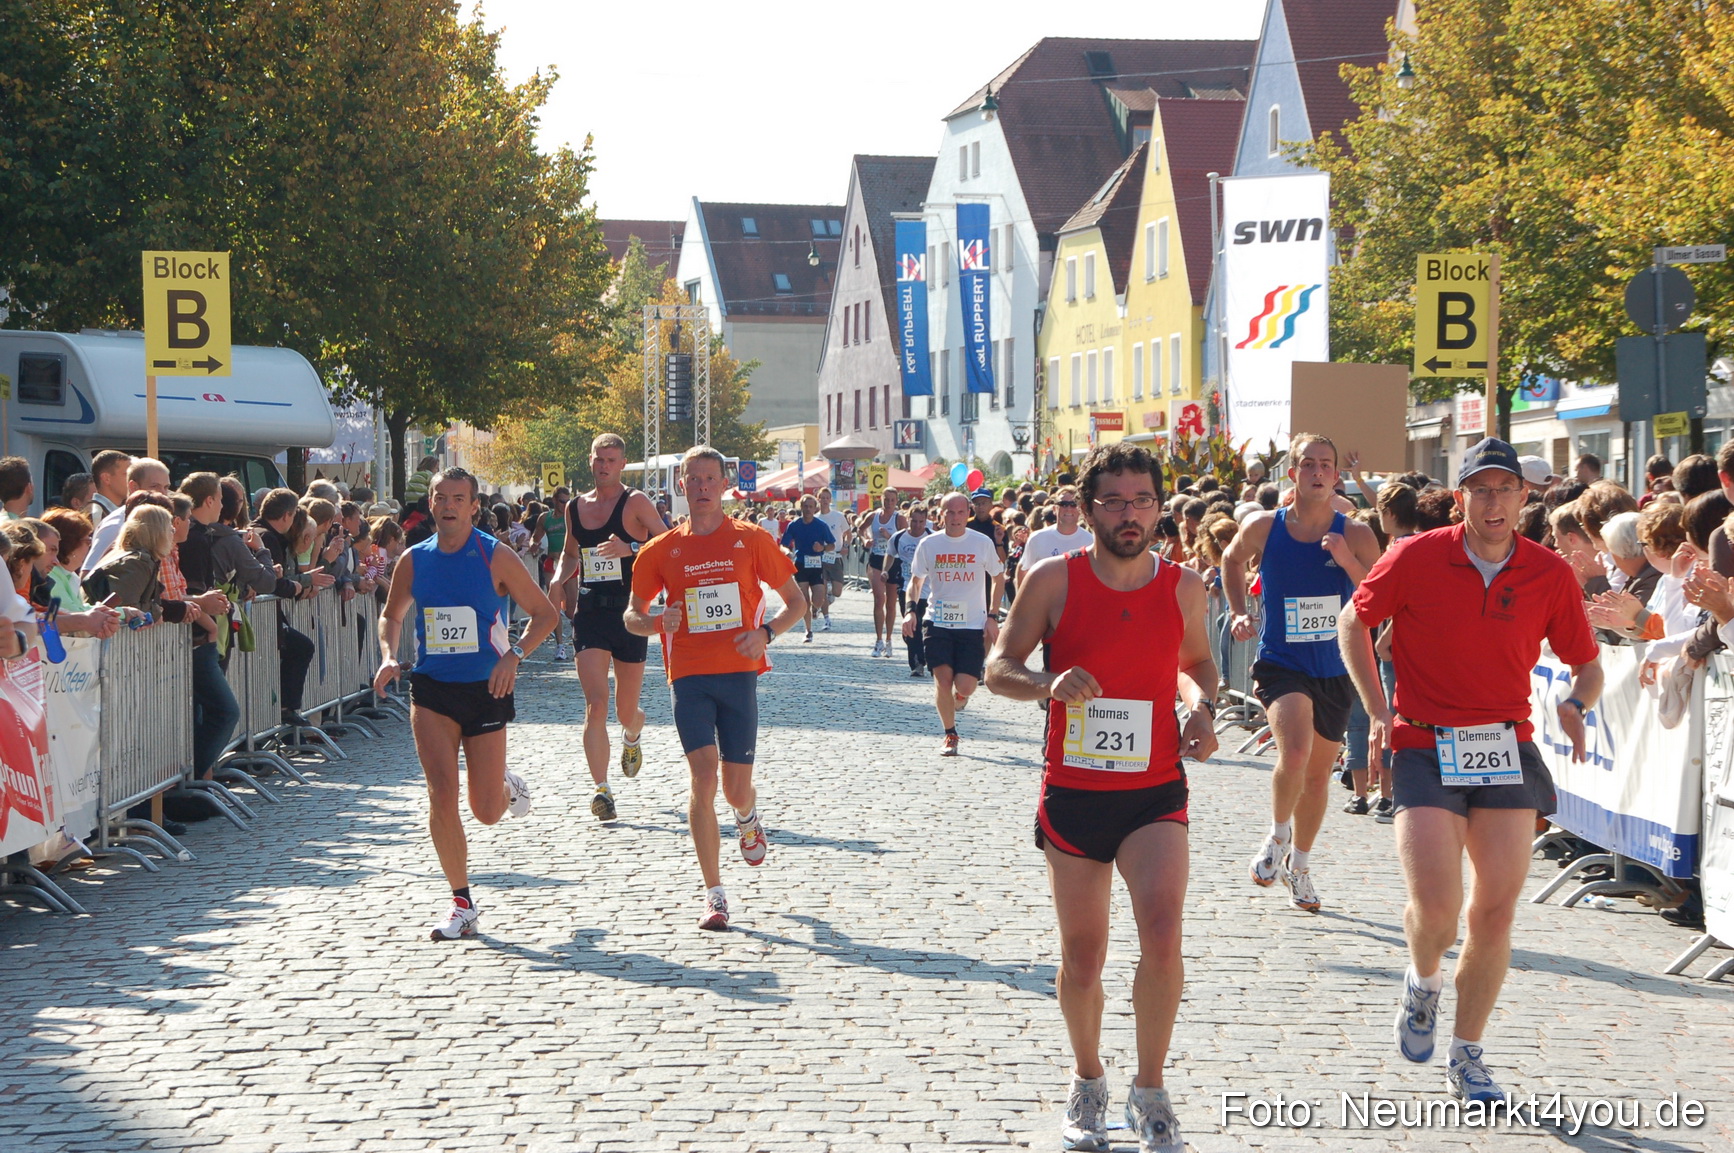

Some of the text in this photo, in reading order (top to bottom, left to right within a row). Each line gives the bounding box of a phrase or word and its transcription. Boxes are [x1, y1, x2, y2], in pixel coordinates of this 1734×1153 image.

[1234, 217, 1323, 245] swn
[1695, 248, 1721, 259] Gasse
[154, 256, 220, 279] Block
[1427, 259, 1490, 281] Block
[973, 275, 985, 343] RUPPERT
[167, 290, 210, 349] B
[1437, 291, 1477, 350] B
[1076, 323, 1096, 345] HOTEL
[1235, 399, 1282, 408] stadtwerke
[548, 471, 560, 488] C
[872, 474, 883, 489] C
[935, 553, 976, 564] MERZ
[594, 560, 614, 572] 973
[684, 559, 734, 573] SportScheck
[936, 571, 975, 582] TEAM
[698, 589, 719, 600] Frank
[705, 604, 732, 618] 993
[1299, 601, 1324, 610] Martin
[436, 611, 452, 622] Jörg
[943, 612, 964, 621] 2871
[1302, 615, 1337, 630] 2879
[441, 626, 467, 640] 927
[1088, 704, 1129, 720] thomas
[1069, 724, 1075, 735] C
[1458, 730, 1501, 742] Clemens
[1095, 730, 1135, 751] 231
[1441, 749, 1447, 758] A
[1462, 750, 1511, 769] 2261
[1115, 760, 1147, 768] PFLEIDERER
